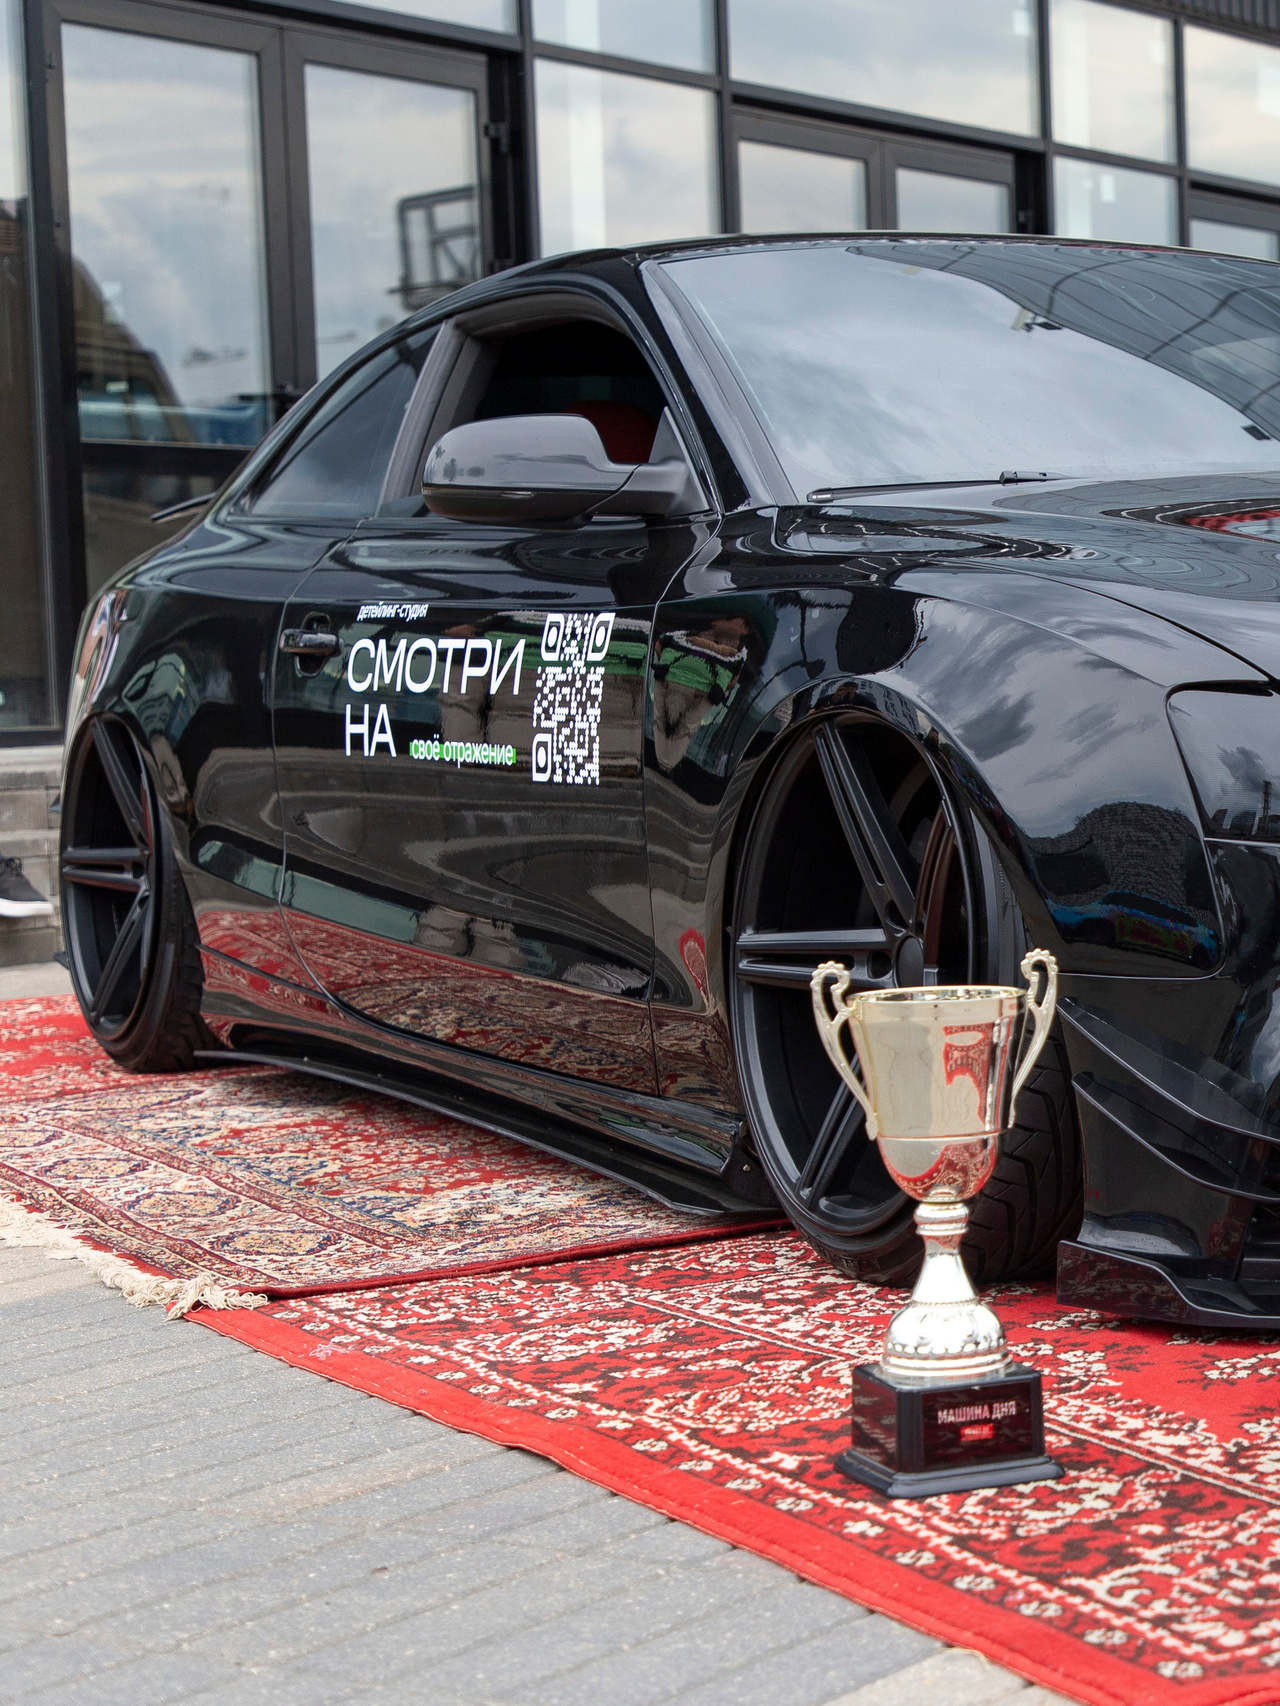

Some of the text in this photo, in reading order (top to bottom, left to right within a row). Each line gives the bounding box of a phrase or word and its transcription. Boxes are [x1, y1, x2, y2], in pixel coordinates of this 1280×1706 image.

[356, 601, 429, 622] детейлинг-студия
[347, 638, 526, 695] СМОТРИ
[345, 703, 397, 757] НА
[411, 733, 514, 769] своё отражение
[937, 1400, 1016, 1425] МАШИНА ДНЯ
